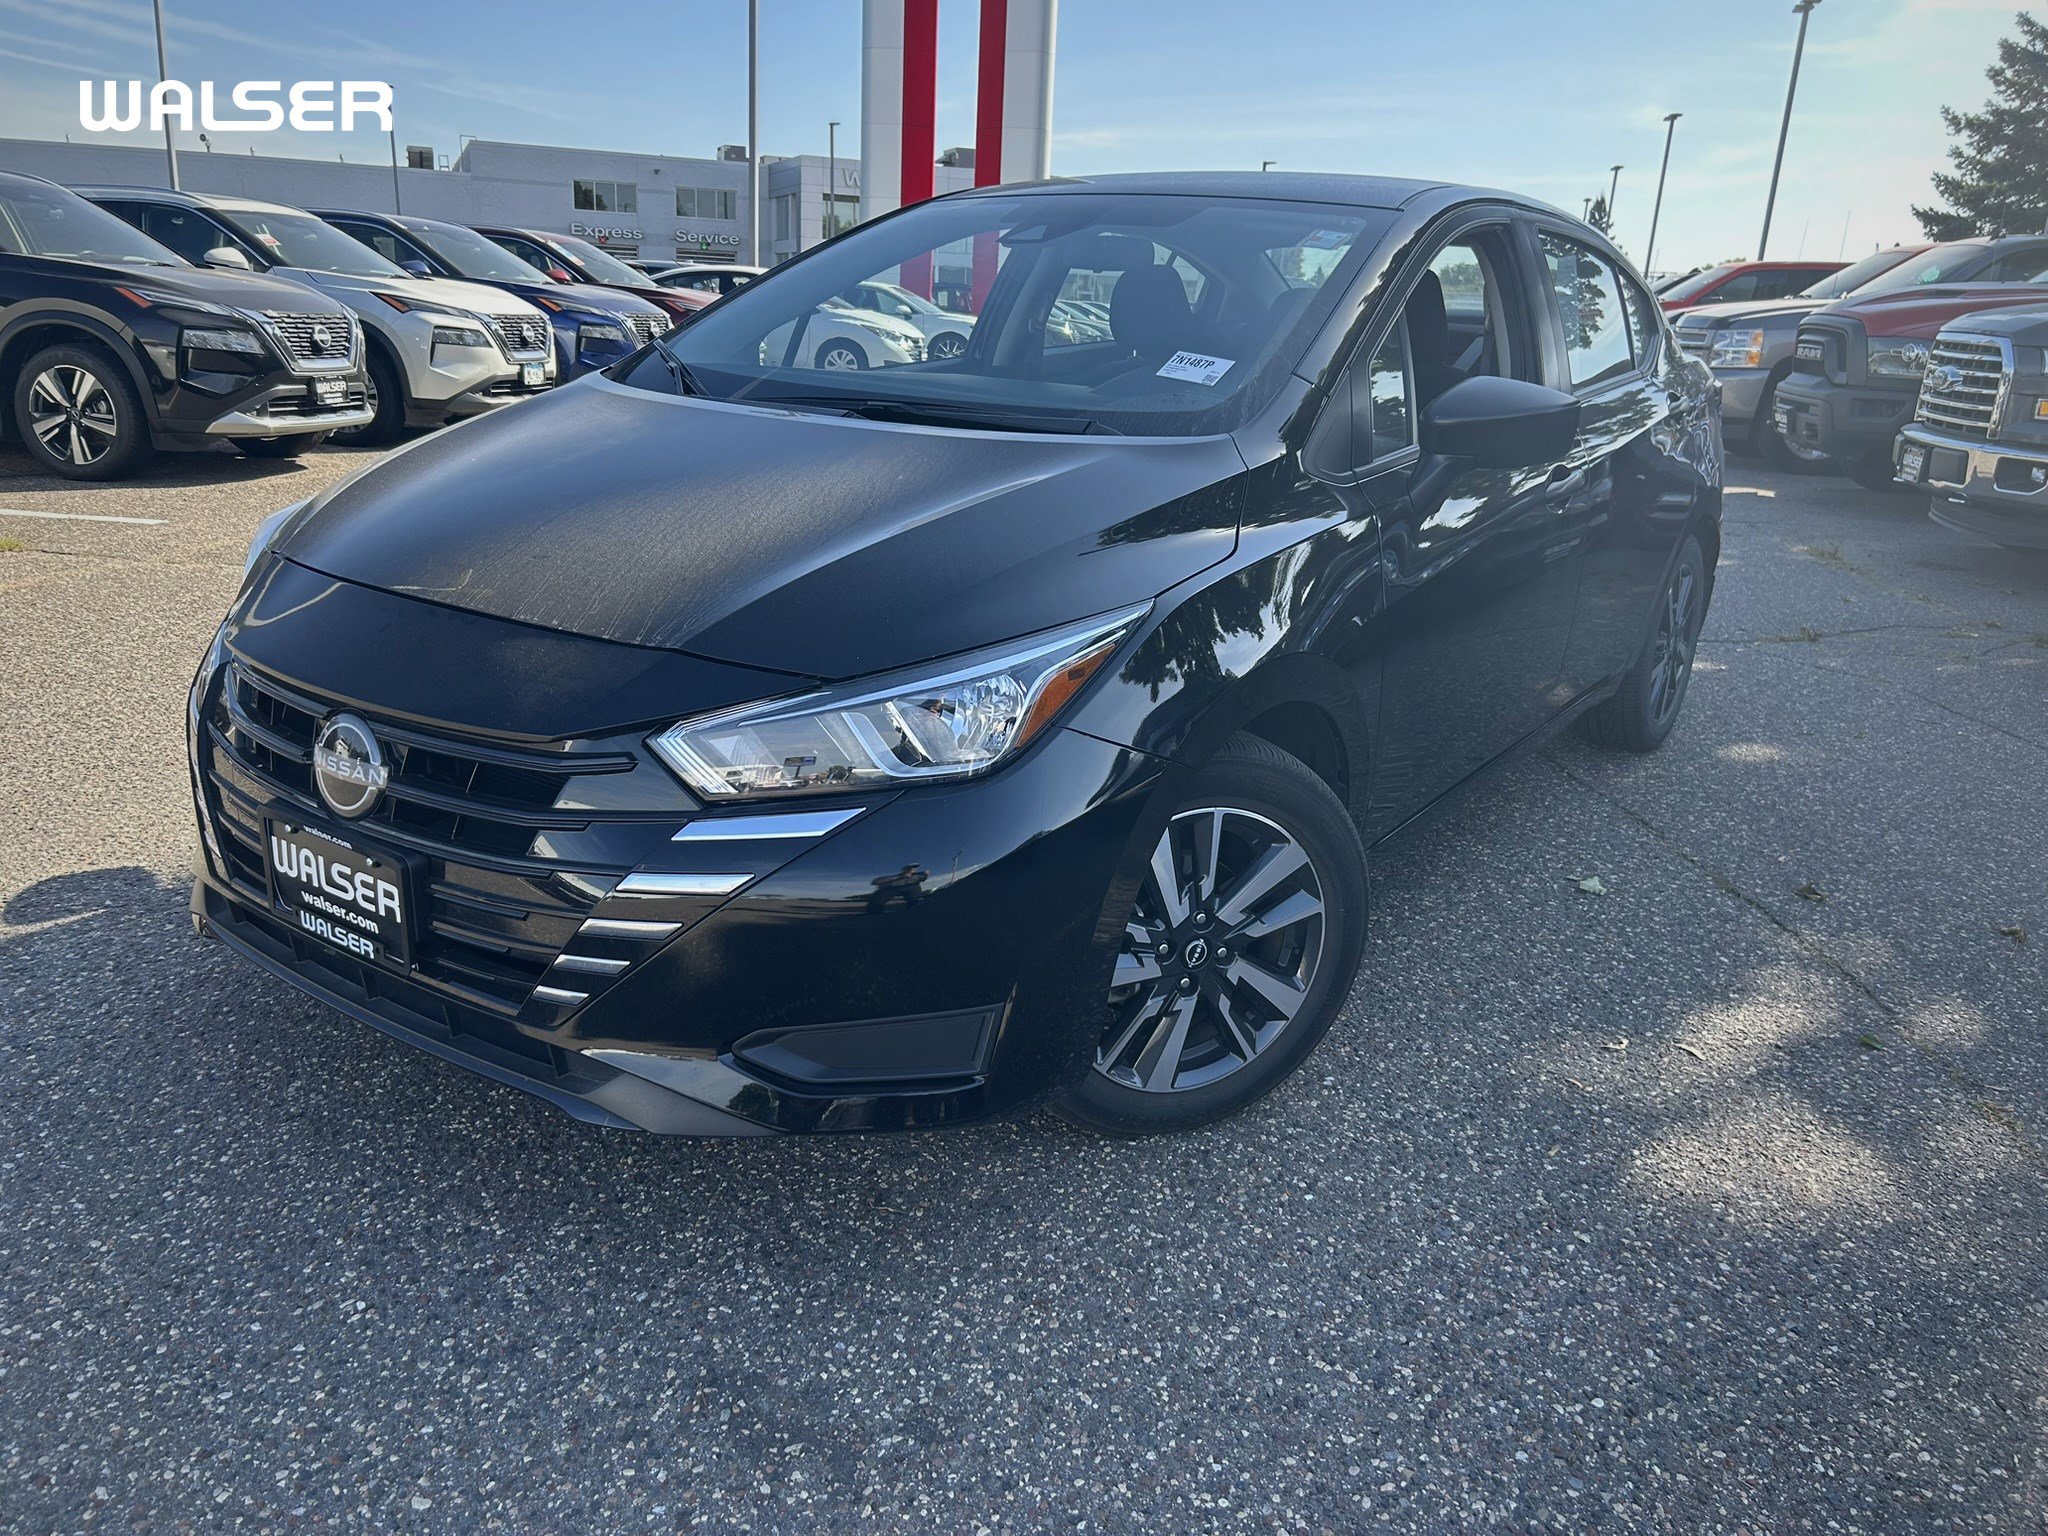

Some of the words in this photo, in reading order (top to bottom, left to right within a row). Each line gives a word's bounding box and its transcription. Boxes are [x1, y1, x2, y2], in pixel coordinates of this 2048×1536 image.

[570, 222, 643, 239] Express
[675, 229, 740, 245] Service
[1171, 354, 1215, 369] 7N1487P
[1796, 347, 1822, 359] RAM
[315, 747, 385, 785] NISSAN
[303, 825, 353, 849] walser.com
[271, 835, 402, 923] WALSER
[301, 890, 379, 934] walser.com
[300, 910, 375, 959] WALSER
